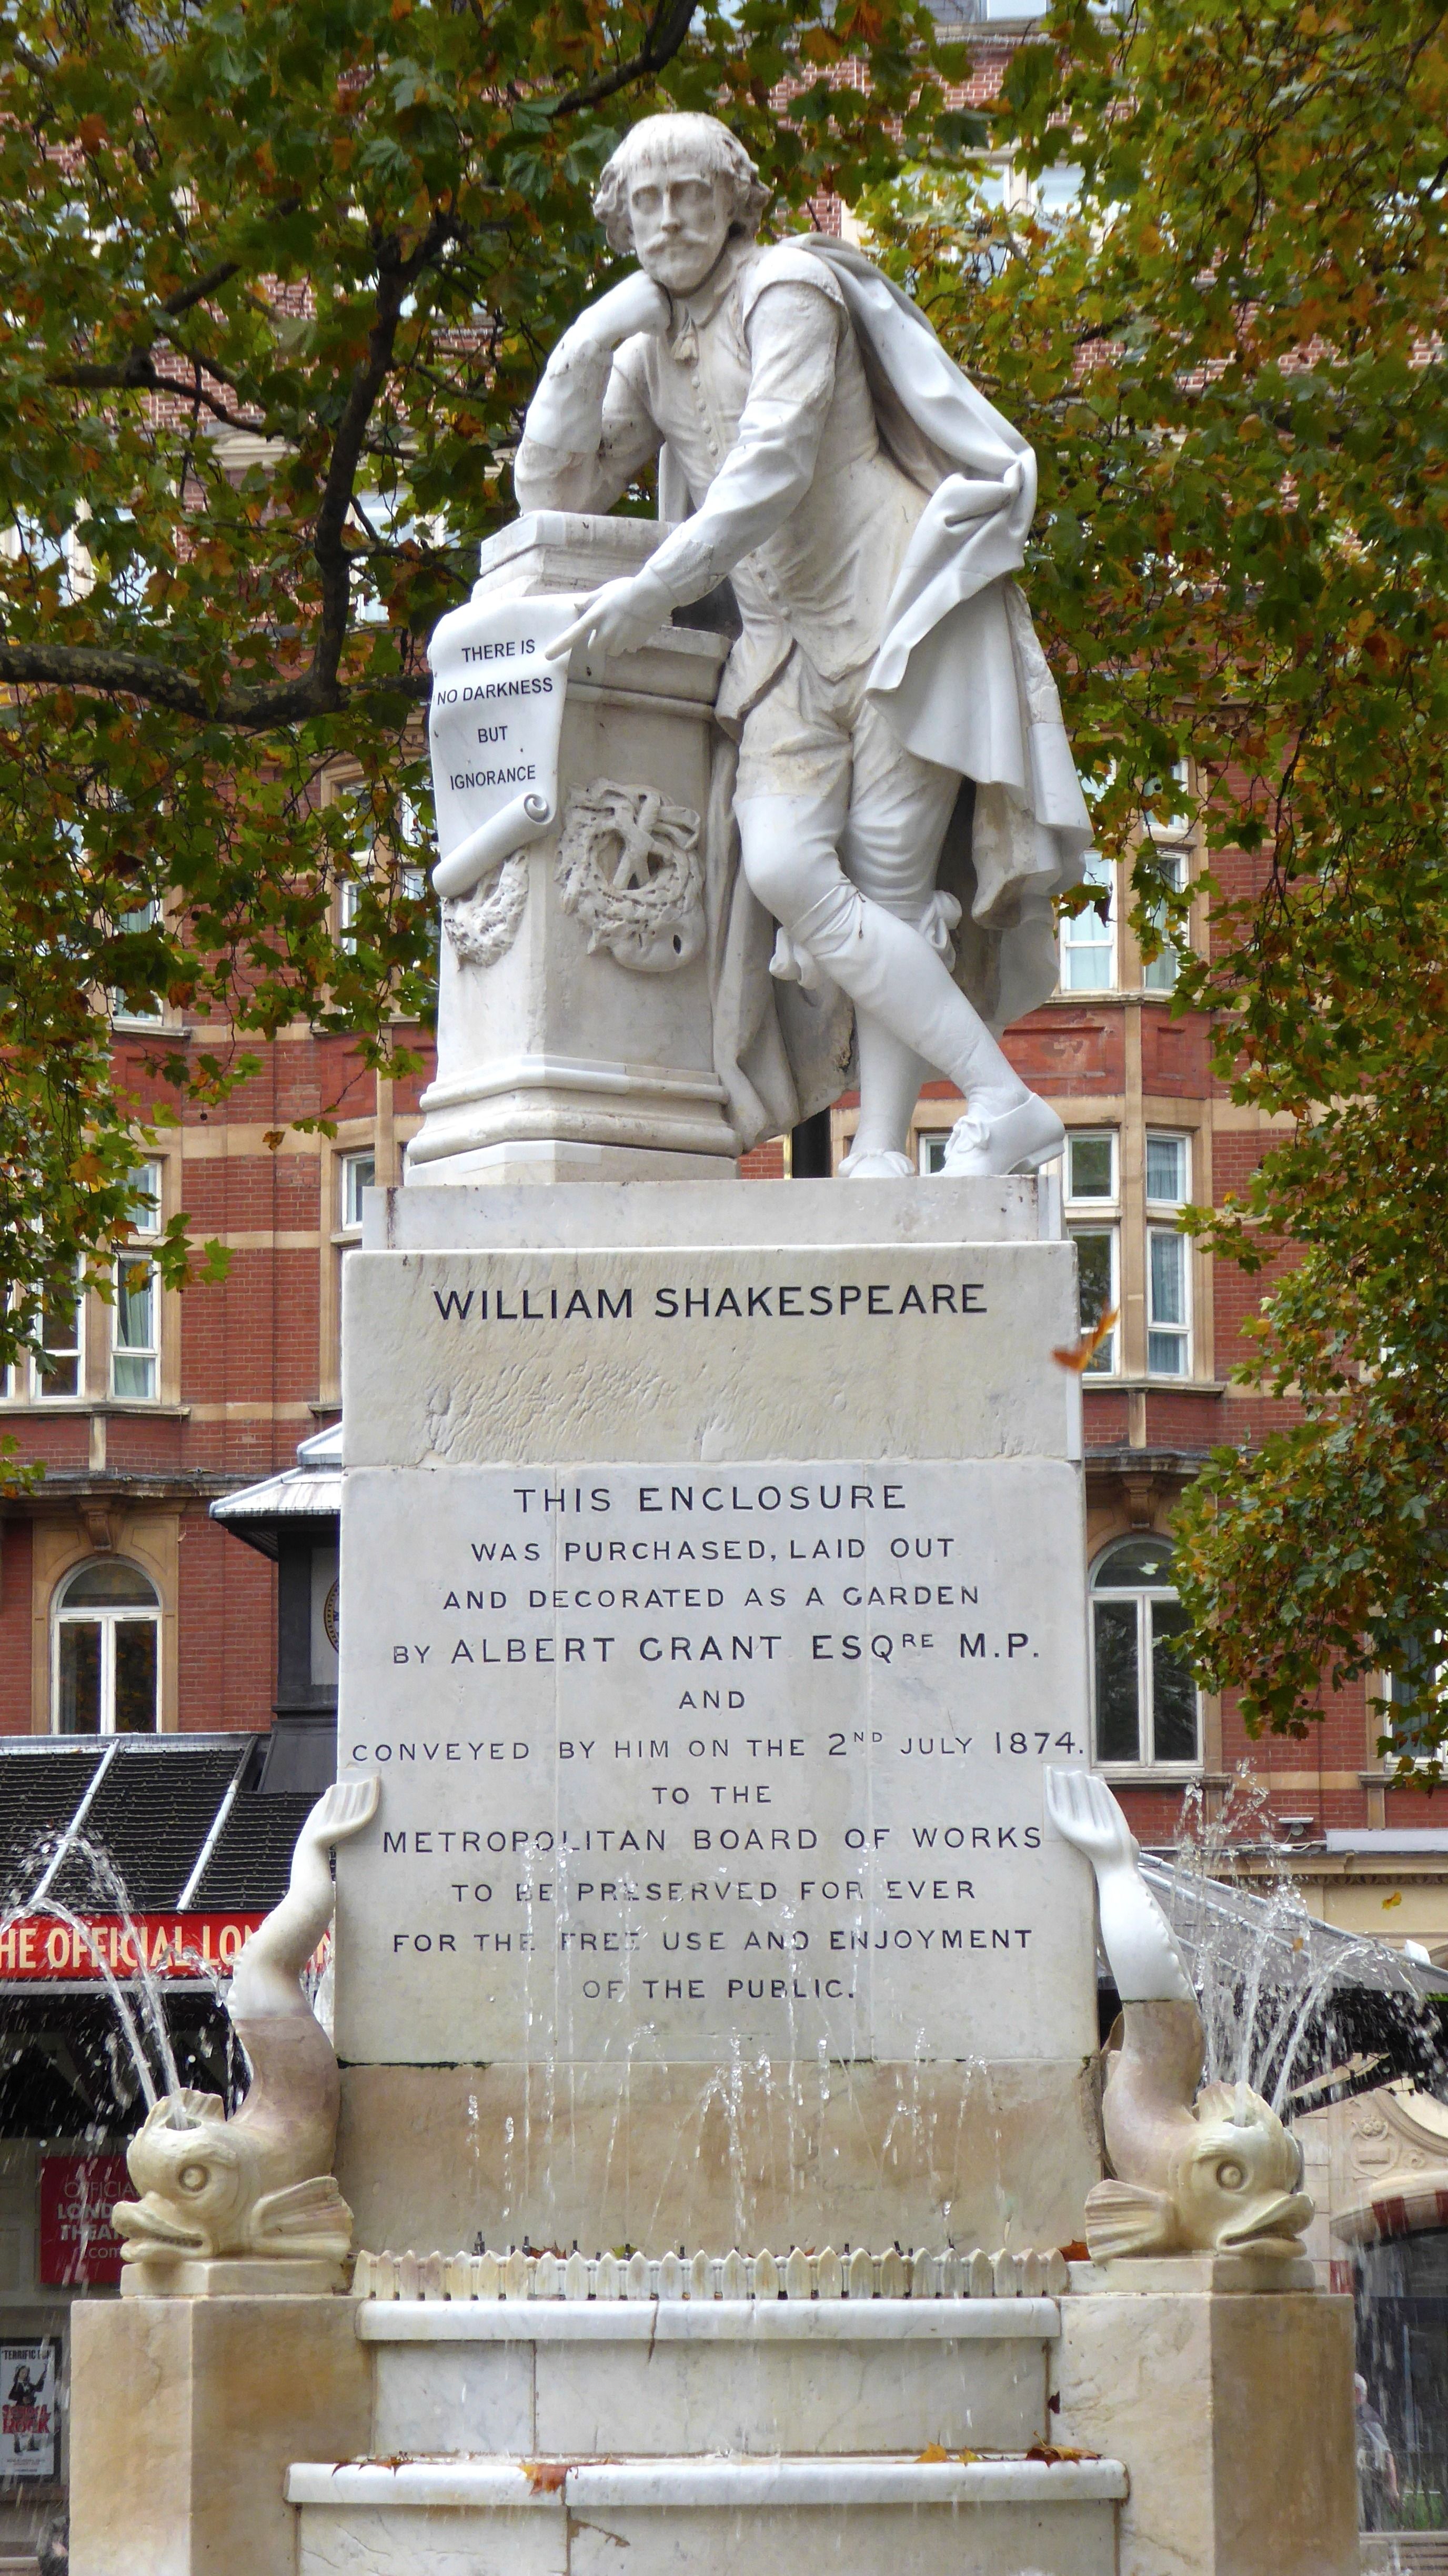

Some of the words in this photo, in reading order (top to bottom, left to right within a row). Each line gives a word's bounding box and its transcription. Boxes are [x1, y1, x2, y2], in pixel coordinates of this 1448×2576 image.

[461, 642, 515, 662] THERE
[521, 639, 535, 655] IS
[437, 689, 458, 705] NO
[463, 677, 553, 701] DARKNESS
[478, 726, 508, 743] BUT
[450, 764, 536, 790] IGNORANCE
[434, 1289, 632, 1320] WILLIAM
[655, 1284, 987, 1317] SHAKESPEARE
[514, 1488, 611, 1513] THIS
[640, 1485, 906, 1512] ENCLOSURE
[471, 1543, 540, 1562] WAS
[565, 1539, 777, 1562] PURCHASED,
[790, 1539, 865, 1558] LAID
[890, 1538, 954, 1558] OUT
[443, 1591, 507, 1610] AND
[529, 1589, 723, 1608] DECORATED
[745, 1587, 786, 1606] AS
[805, 1587, 824, 1606] A
[843, 1586, 978, 1605] GARDEN
[393, 1645, 430, 1664] BY
[451, 1637, 615, 1664] ALBERT
[639, 1636, 781, 1662] GRANT
[960, 1633, 1039, 1658] M.P.
[679, 1690, 745, 1709] AND
[353, 1743, 529, 1762] CONVEYED
[559, 1741, 595, 1759] BY
[615, 1740, 668, 1758] HIM
[689, 1739, 729, 1757] ON
[747, 1739, 804, 1757] THE
[900, 1736, 972, 1755] JULY
[995, 1732, 1083, 1755] 1874.
[652, 1787, 689, 1804] TO
[710, 1786, 771, 1804] THE
[383, 1830, 665, 1853] METROPOLITAN
[695, 1828, 817, 1850] BOARD
[845, 1828, 890, 1849] OF
[912, 1827, 1041, 1848] WORKS
[451, 1884, 492, 1901] TO
[516, 1883, 552, 1901] BE
[578, 1882, 777, 1901] PRESERVED
[801, 1881, 863, 1900] FOR
[887, 1880, 975, 1900] EVER
[394, 1934, 456, 1952] FOR
[474, 1934, 535, 1951] THE
[561, 1932, 640, 1951] FREE
[663, 1932, 725, 1950] USE
[745, 1930, 809, 1950] AND
[831, 1929, 1032, 1950] ENJOYMENT
[583, 1980, 623, 1999] OF
[642, 1979, 705, 1998] THE
[729, 1979, 854, 1998] PUBLIC.
